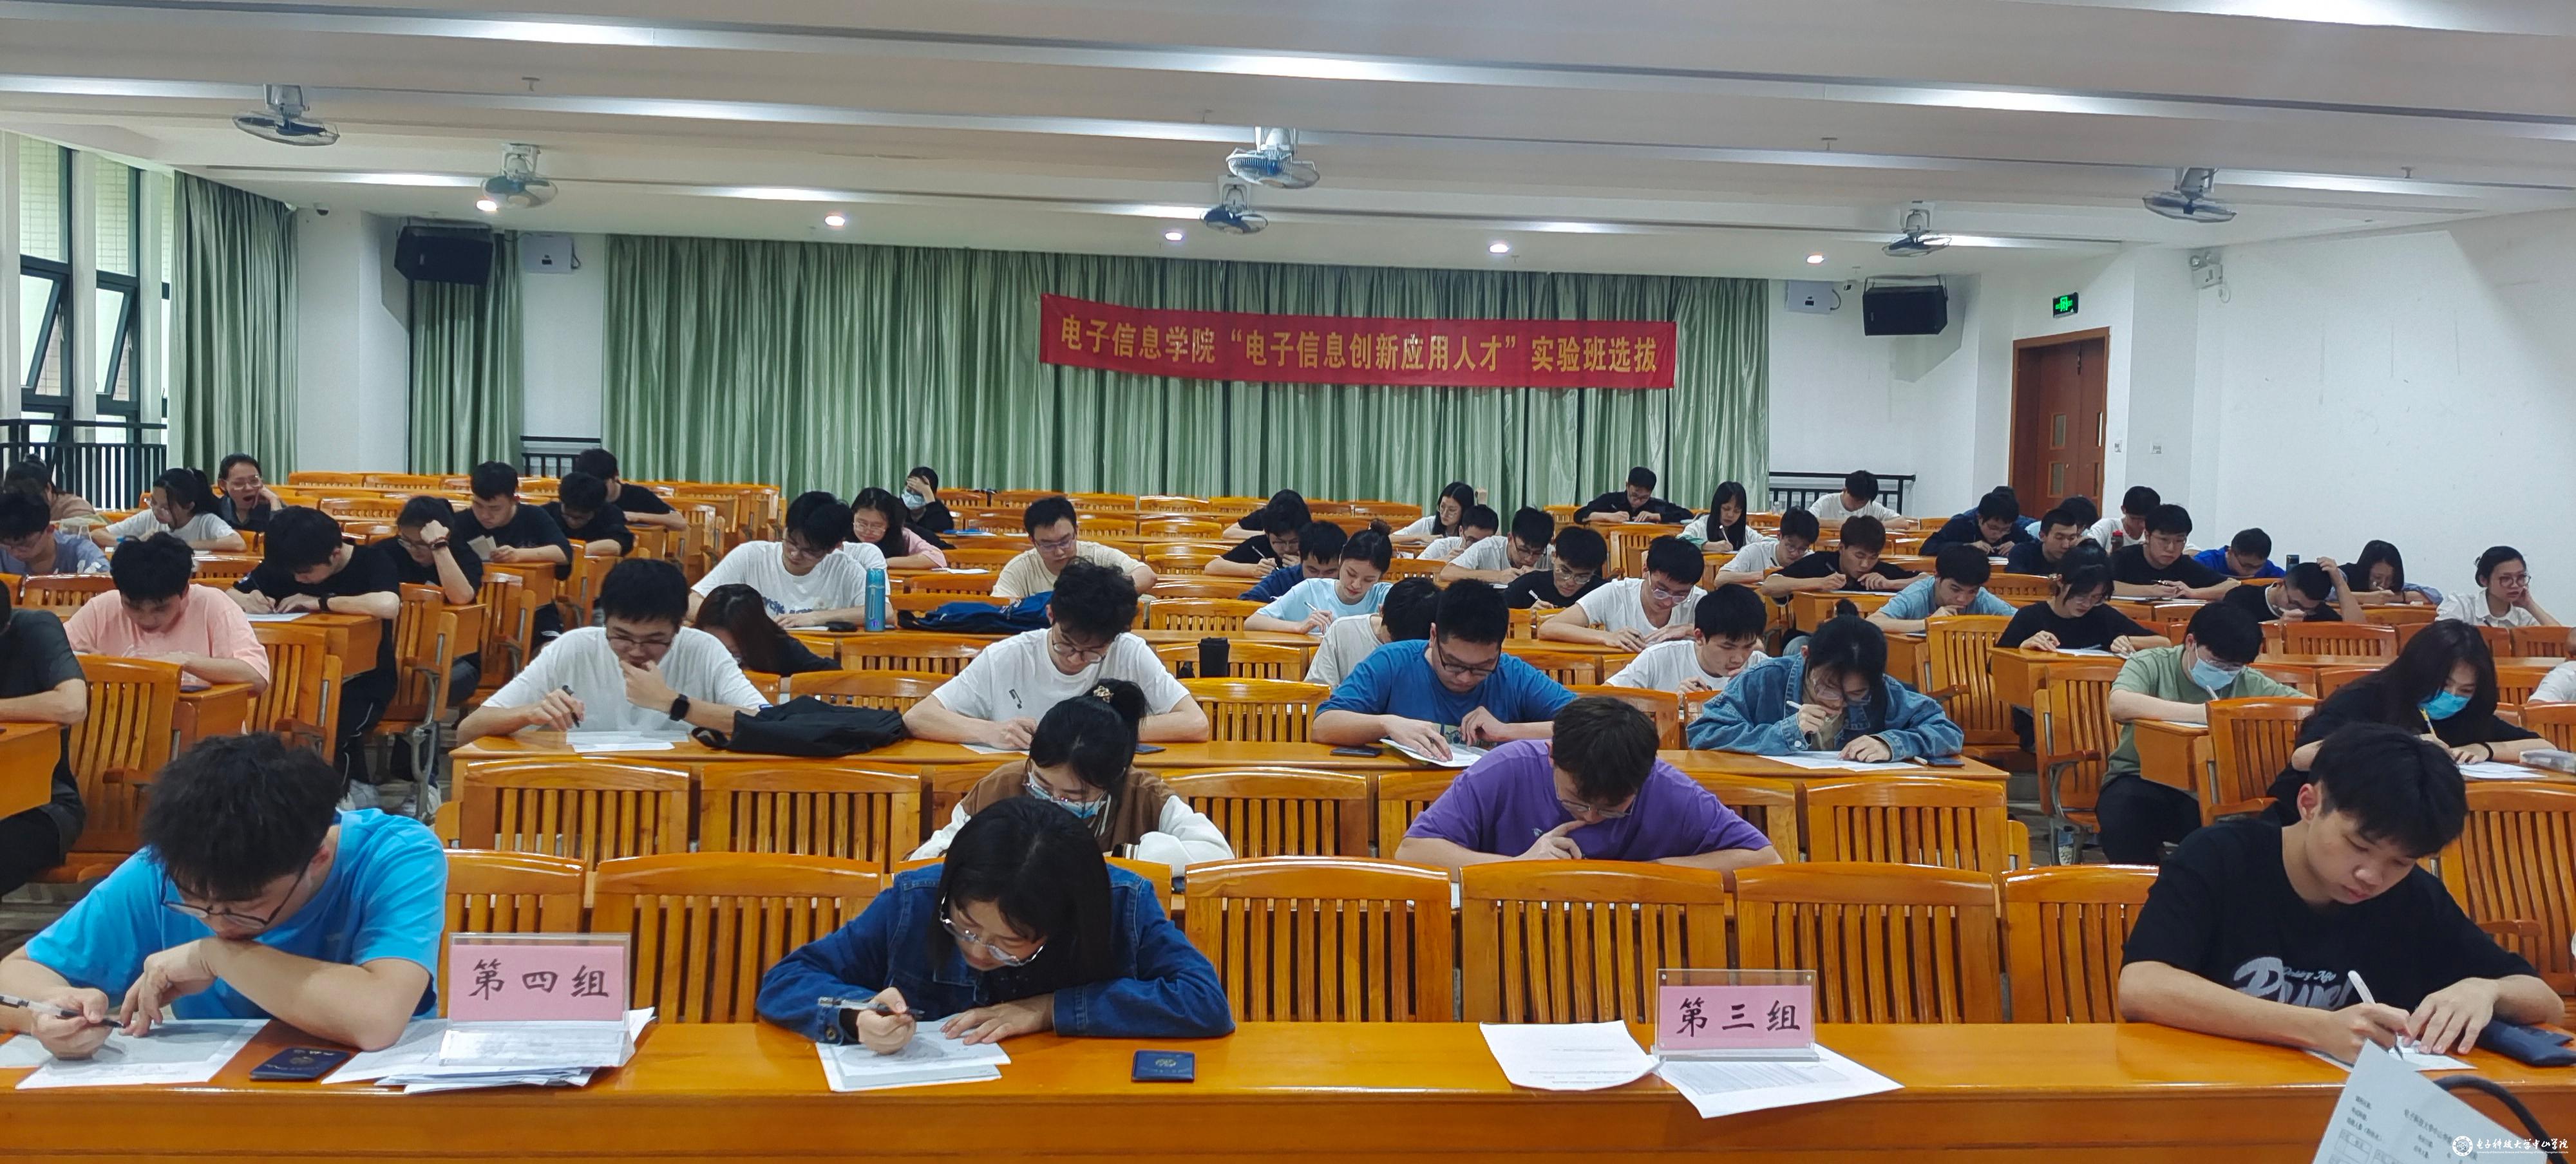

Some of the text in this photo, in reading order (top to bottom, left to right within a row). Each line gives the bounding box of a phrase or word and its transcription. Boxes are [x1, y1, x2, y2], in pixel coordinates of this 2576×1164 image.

[469, 958, 609, 1000] 第四组
[1676, 997, 1801, 1037] 第三组
